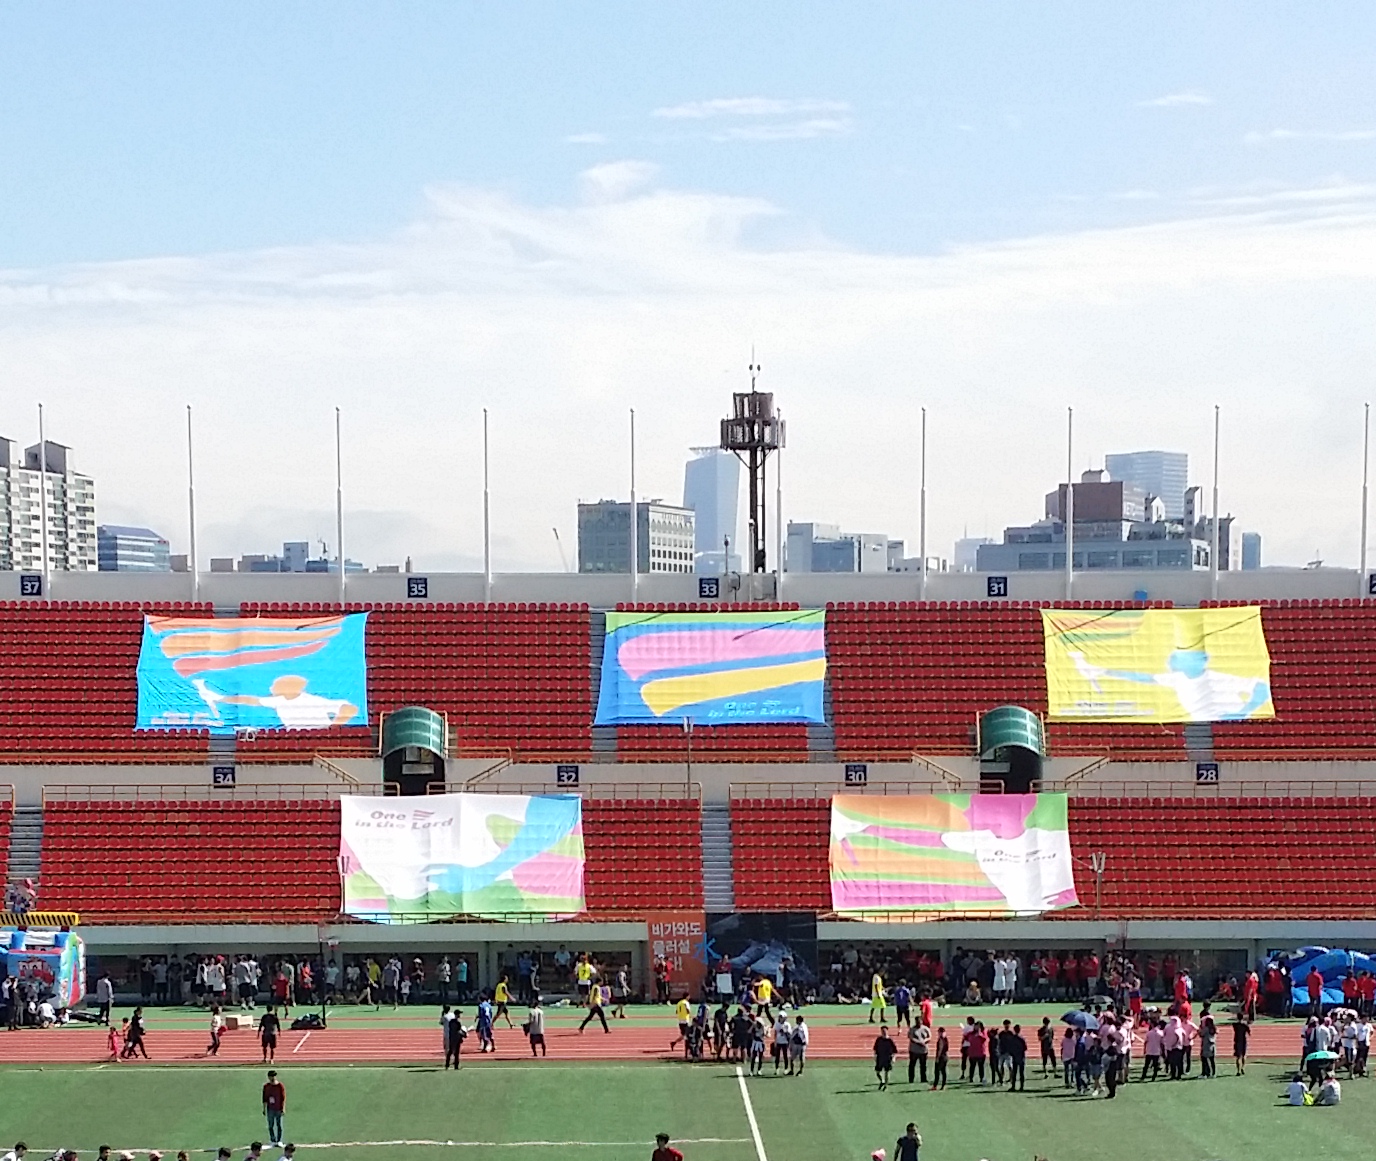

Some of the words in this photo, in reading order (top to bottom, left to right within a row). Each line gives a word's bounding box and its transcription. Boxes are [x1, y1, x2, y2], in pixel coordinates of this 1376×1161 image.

[23, 581, 40, 594] 37
[410, 584, 426, 596] 35
[701, 584, 717, 596] 33
[990, 583, 1004, 595] 31
[216, 773, 233, 785] 34
[559, 773, 576, 784] 32
[848, 772, 865, 783] 30
[1198, 770, 1216, 782] 28
[370, 810, 407, 820] One
[411, 817, 454, 830] Lord
[651, 922, 702, 937] 비가와도
